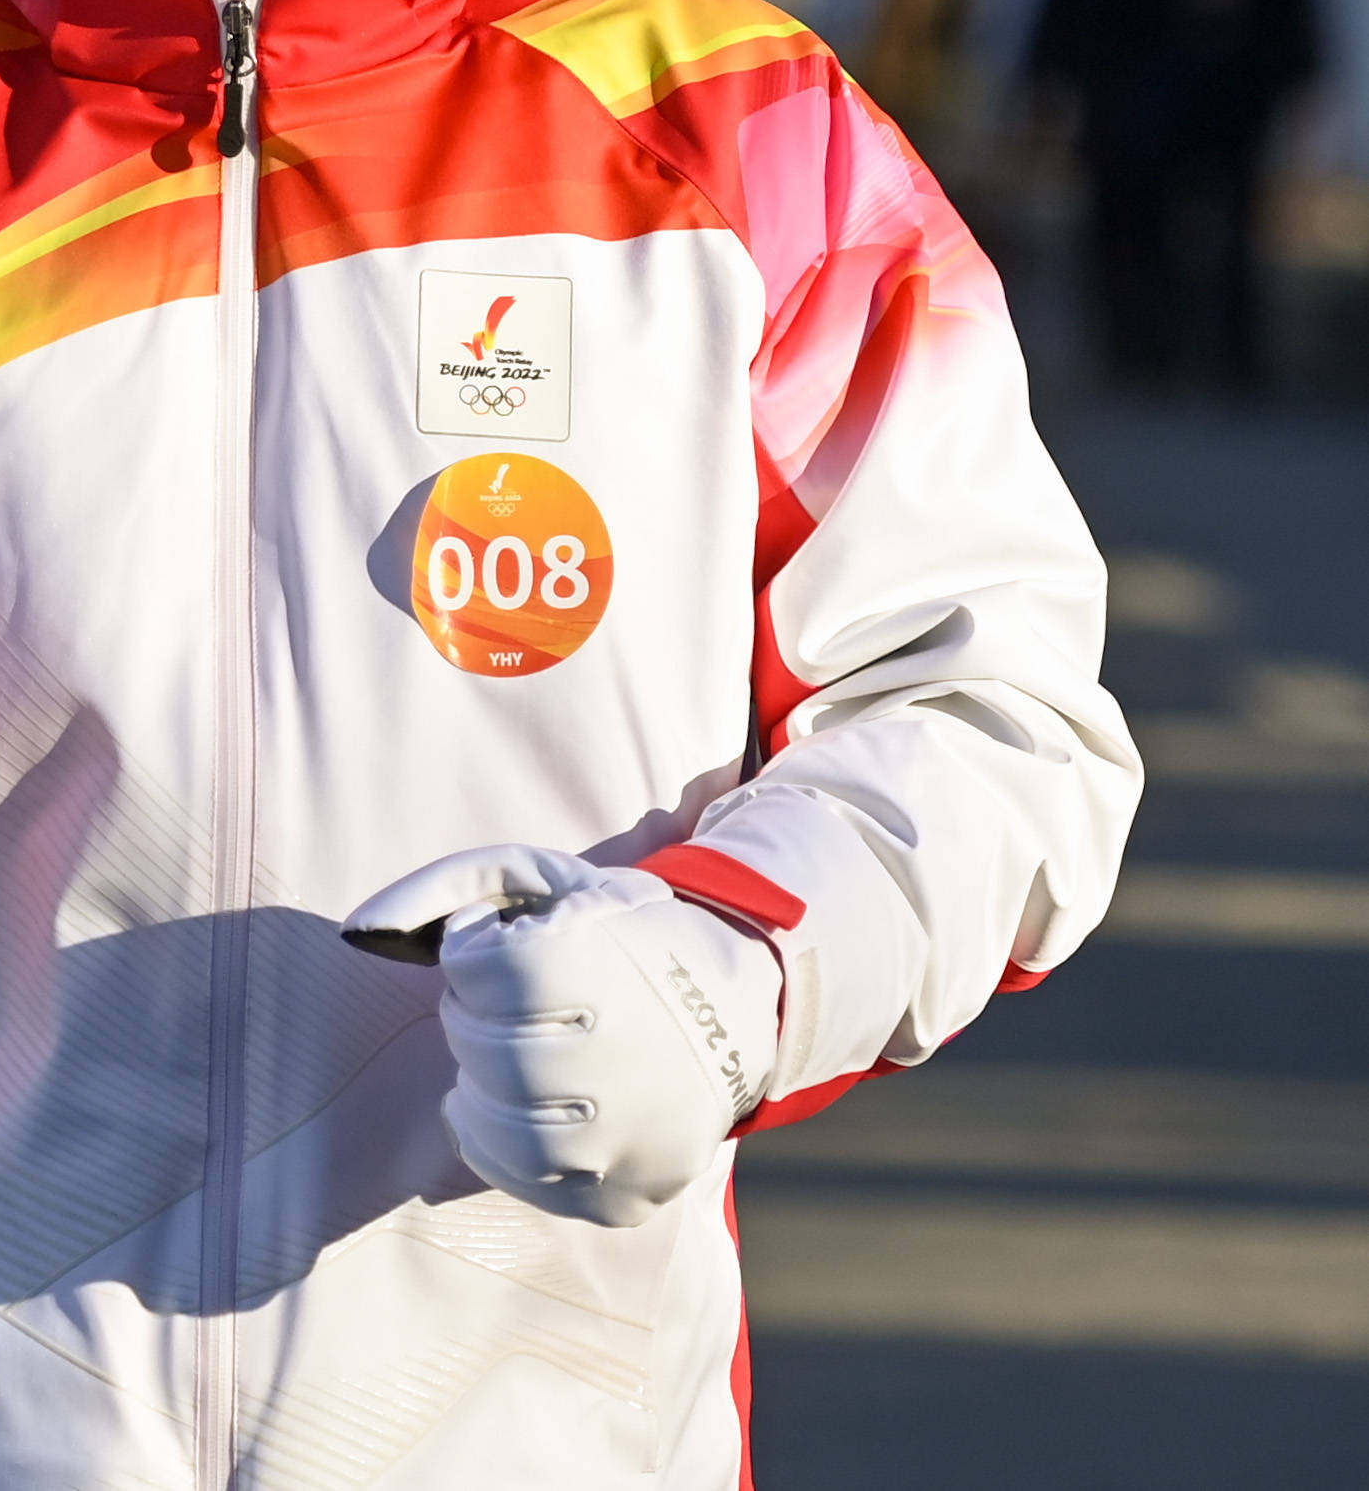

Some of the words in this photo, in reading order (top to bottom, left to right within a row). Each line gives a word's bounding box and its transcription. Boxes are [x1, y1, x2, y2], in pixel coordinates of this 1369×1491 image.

[439, 363, 496, 381] BEIJING
[428, 534, 590, 612] 008
[489, 652, 523, 666] YHY
[666, 950, 727, 1051] 2022
